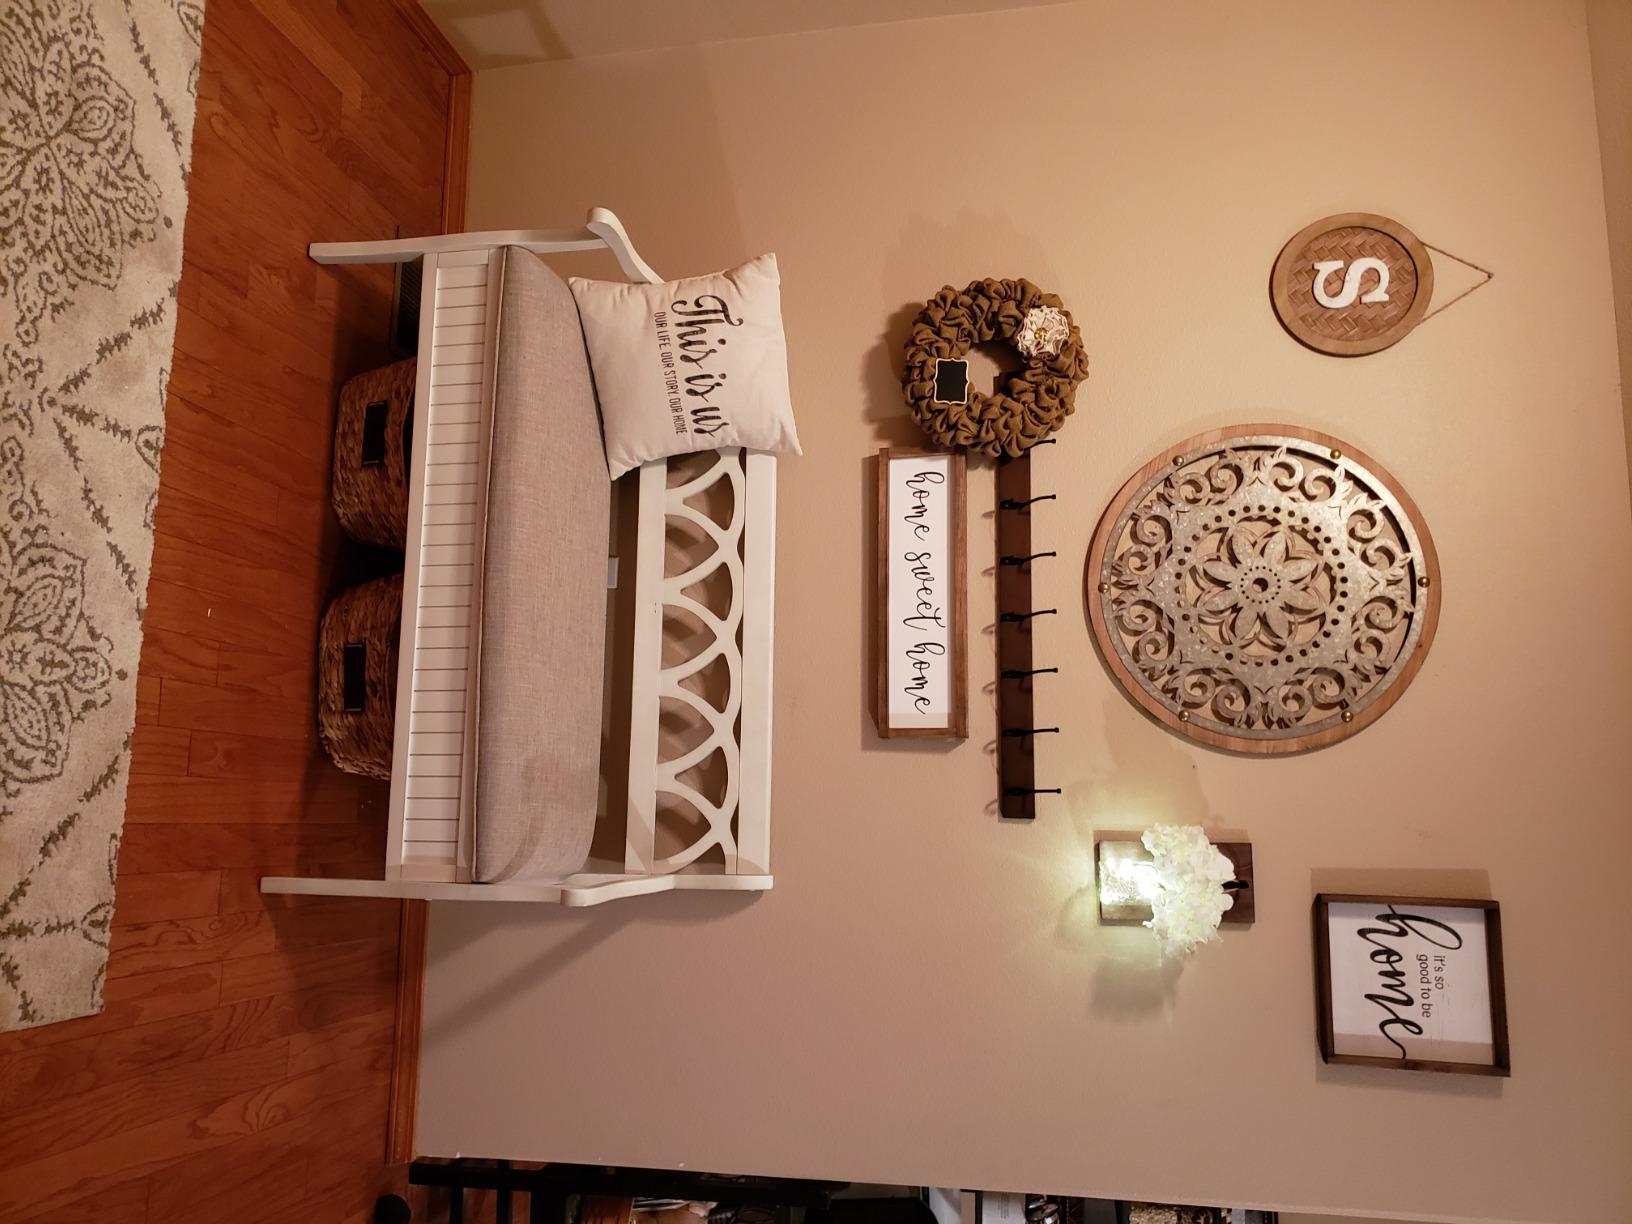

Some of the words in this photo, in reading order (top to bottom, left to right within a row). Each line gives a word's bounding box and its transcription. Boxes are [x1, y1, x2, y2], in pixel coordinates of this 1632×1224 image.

[1312, 257, 1390, 309] S
[654, 311, 668, 330] OUR
[670, 294, 743, 369] This
[660, 351, 675, 369] OUR
[684, 373, 727, 402] is
[669, 398, 684, 415] OUR
[690, 406, 730, 438] us
[904, 471, 945, 541] home
[903, 551, 946, 631] sweet
[904, 642, 946, 715] home
[1416, 953, 1432, 984] good
[1433, 954, 1446, 972] it's
[1356, 903, 1463, 1060] home
[1420, 985, 1432, 1000] to
[1434, 975, 1444, 990] so
[1421, 1003, 1432, 1018] be
